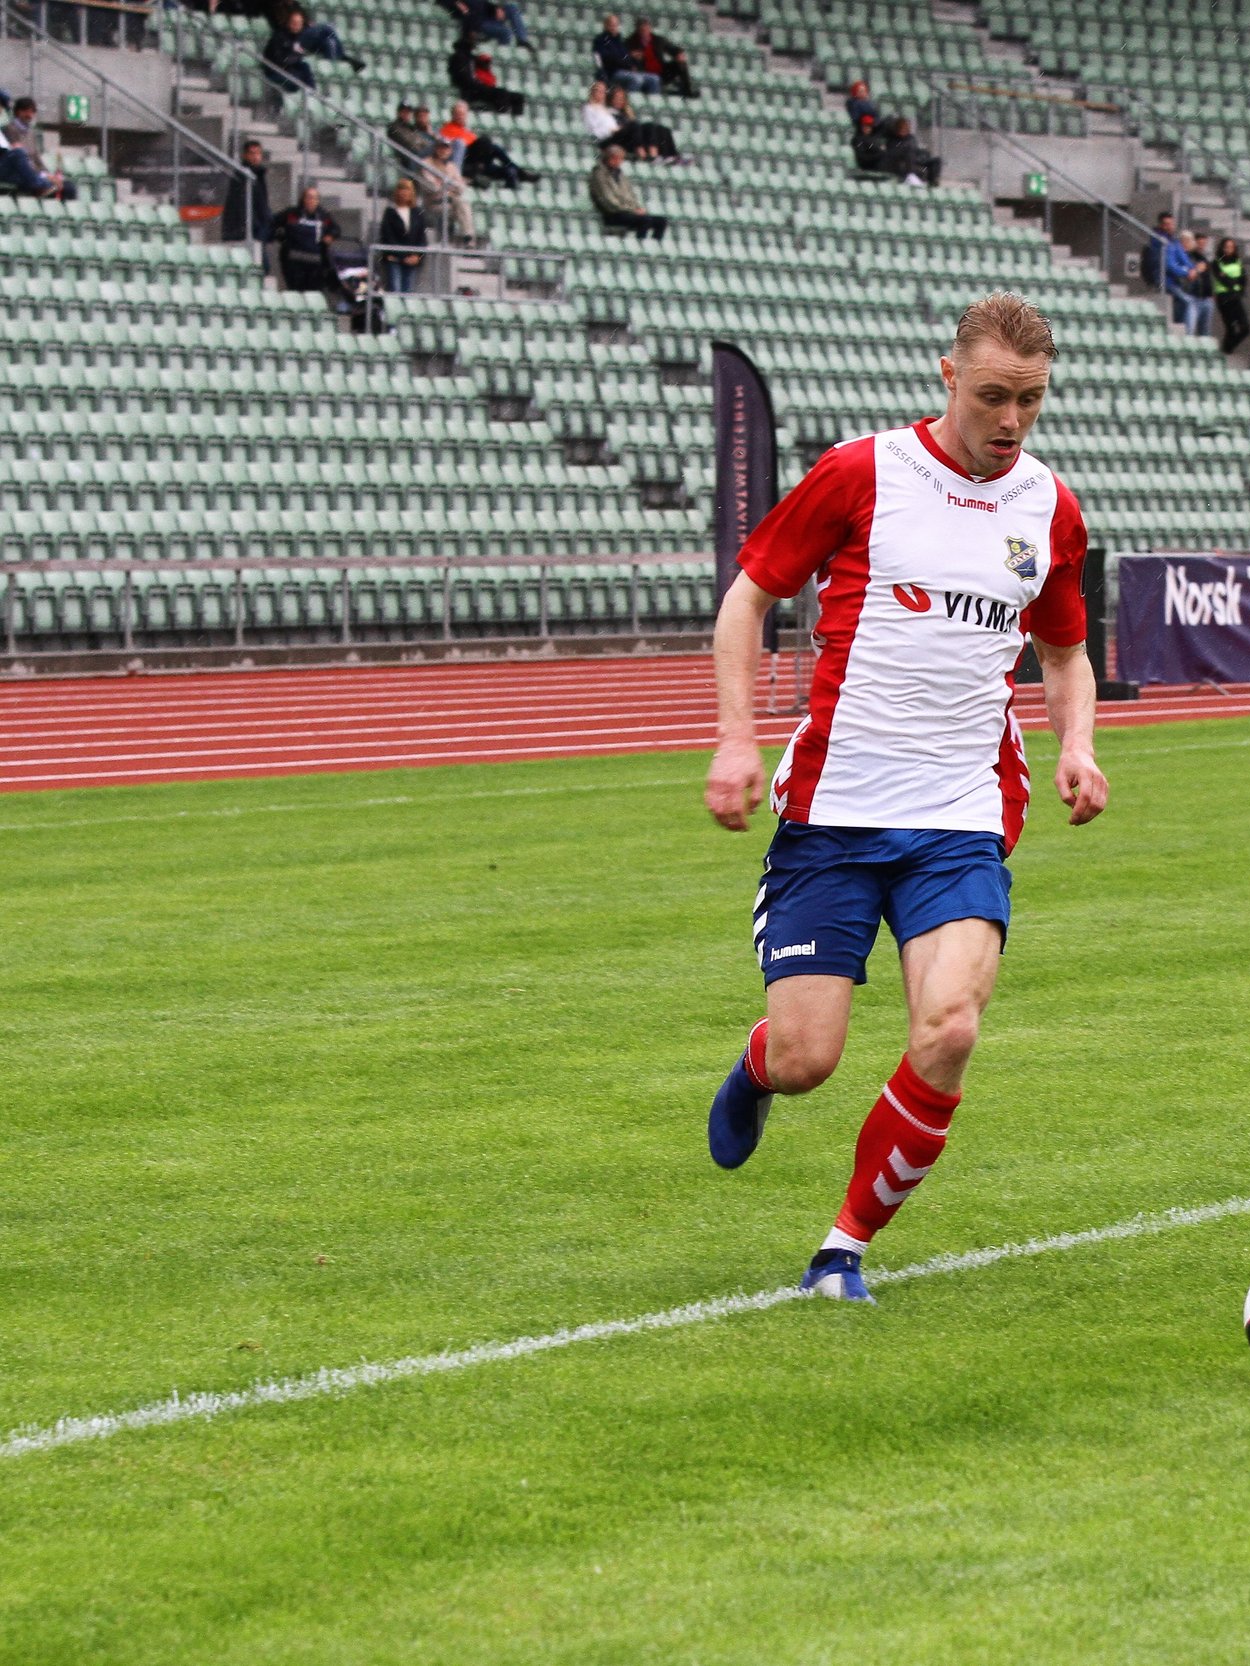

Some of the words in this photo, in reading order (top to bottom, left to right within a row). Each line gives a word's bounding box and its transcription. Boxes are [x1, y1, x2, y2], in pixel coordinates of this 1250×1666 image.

[885, 441, 931, 480] SISSENER
[947, 492, 998, 513] hummel
[1000, 477, 1037, 504] SISSENER
[1165, 565, 1242, 626] Norsk
[770, 940, 816, 961] hummel
